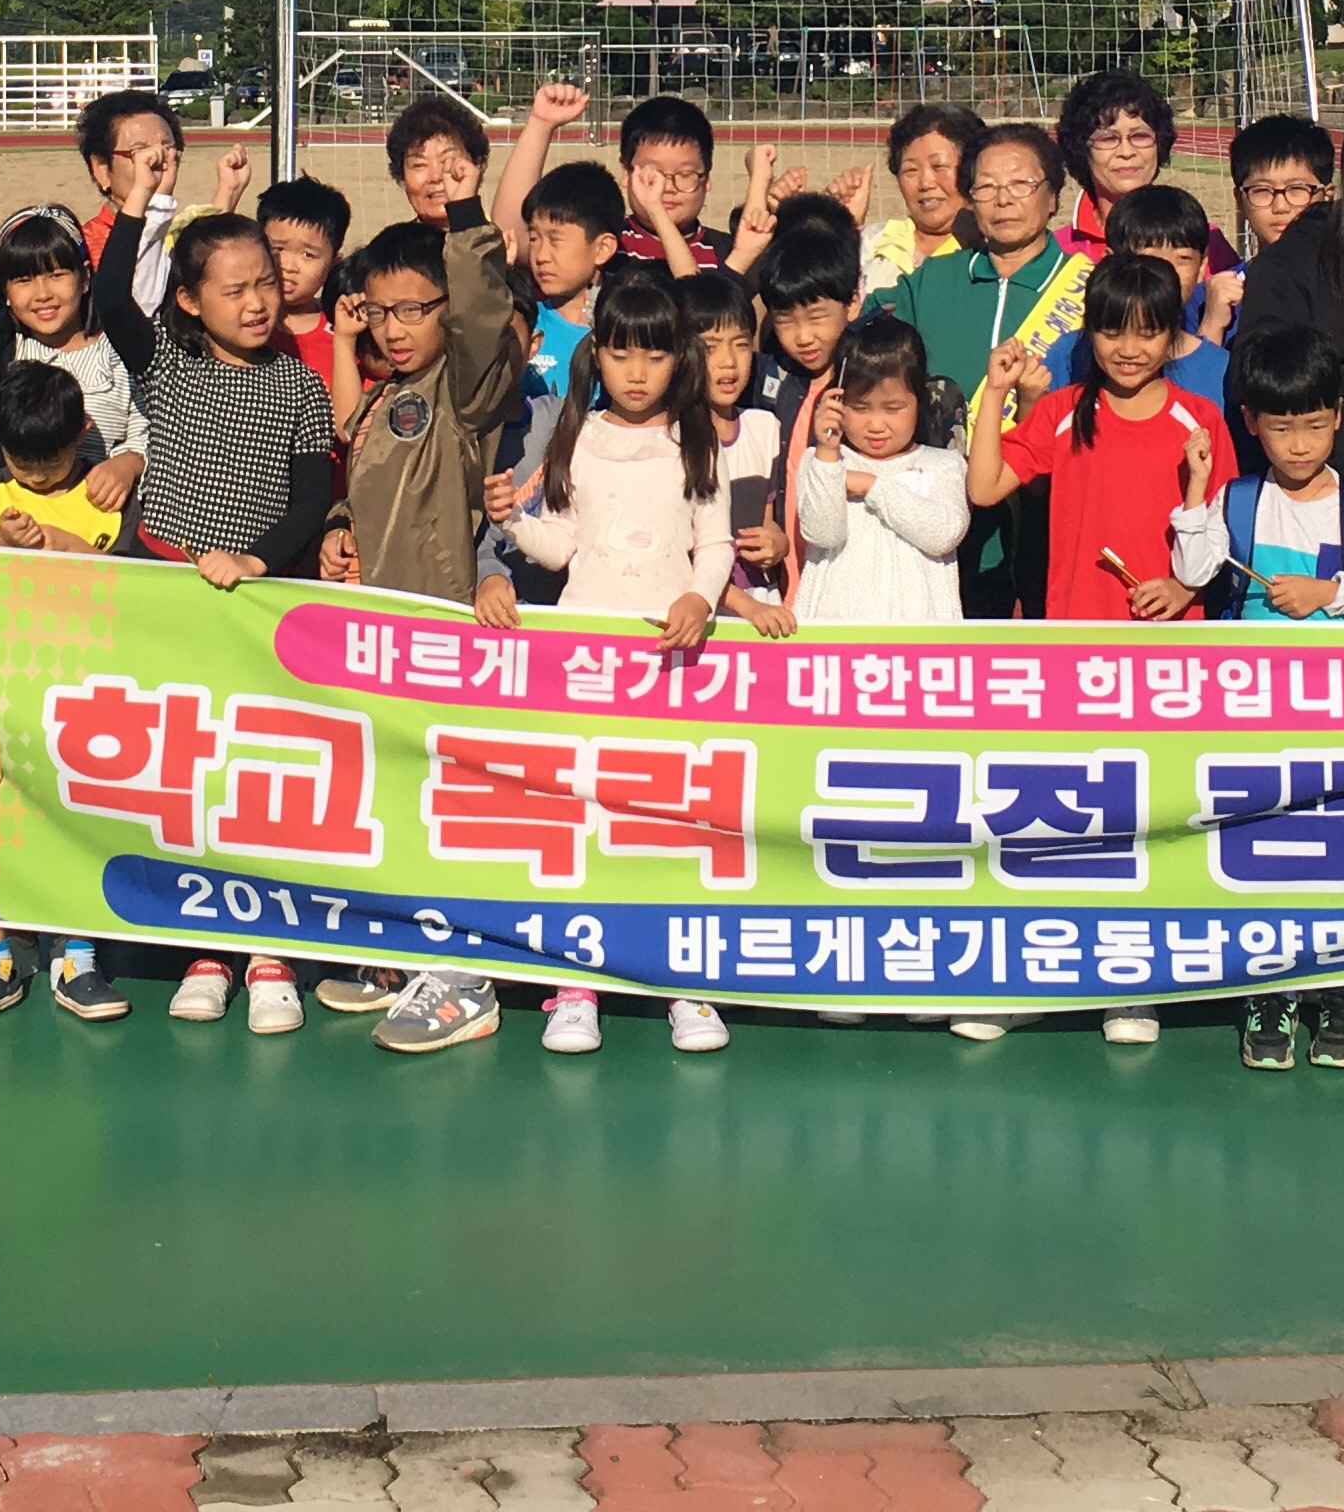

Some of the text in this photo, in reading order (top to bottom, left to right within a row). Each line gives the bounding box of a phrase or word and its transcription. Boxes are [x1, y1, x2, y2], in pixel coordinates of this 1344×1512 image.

[345, 621, 531, 698] 바르게
[562, 644, 757, 712] 살기가
[786, 653, 1046, 719] 대한민국
[46, 677, 381, 864] 학교
[424, 727, 755, 888] 폭력
[803, 749, 1149, 890] 근절
[177, 872, 384, 935] 2017.
[515, 912, 606, 968] 13
